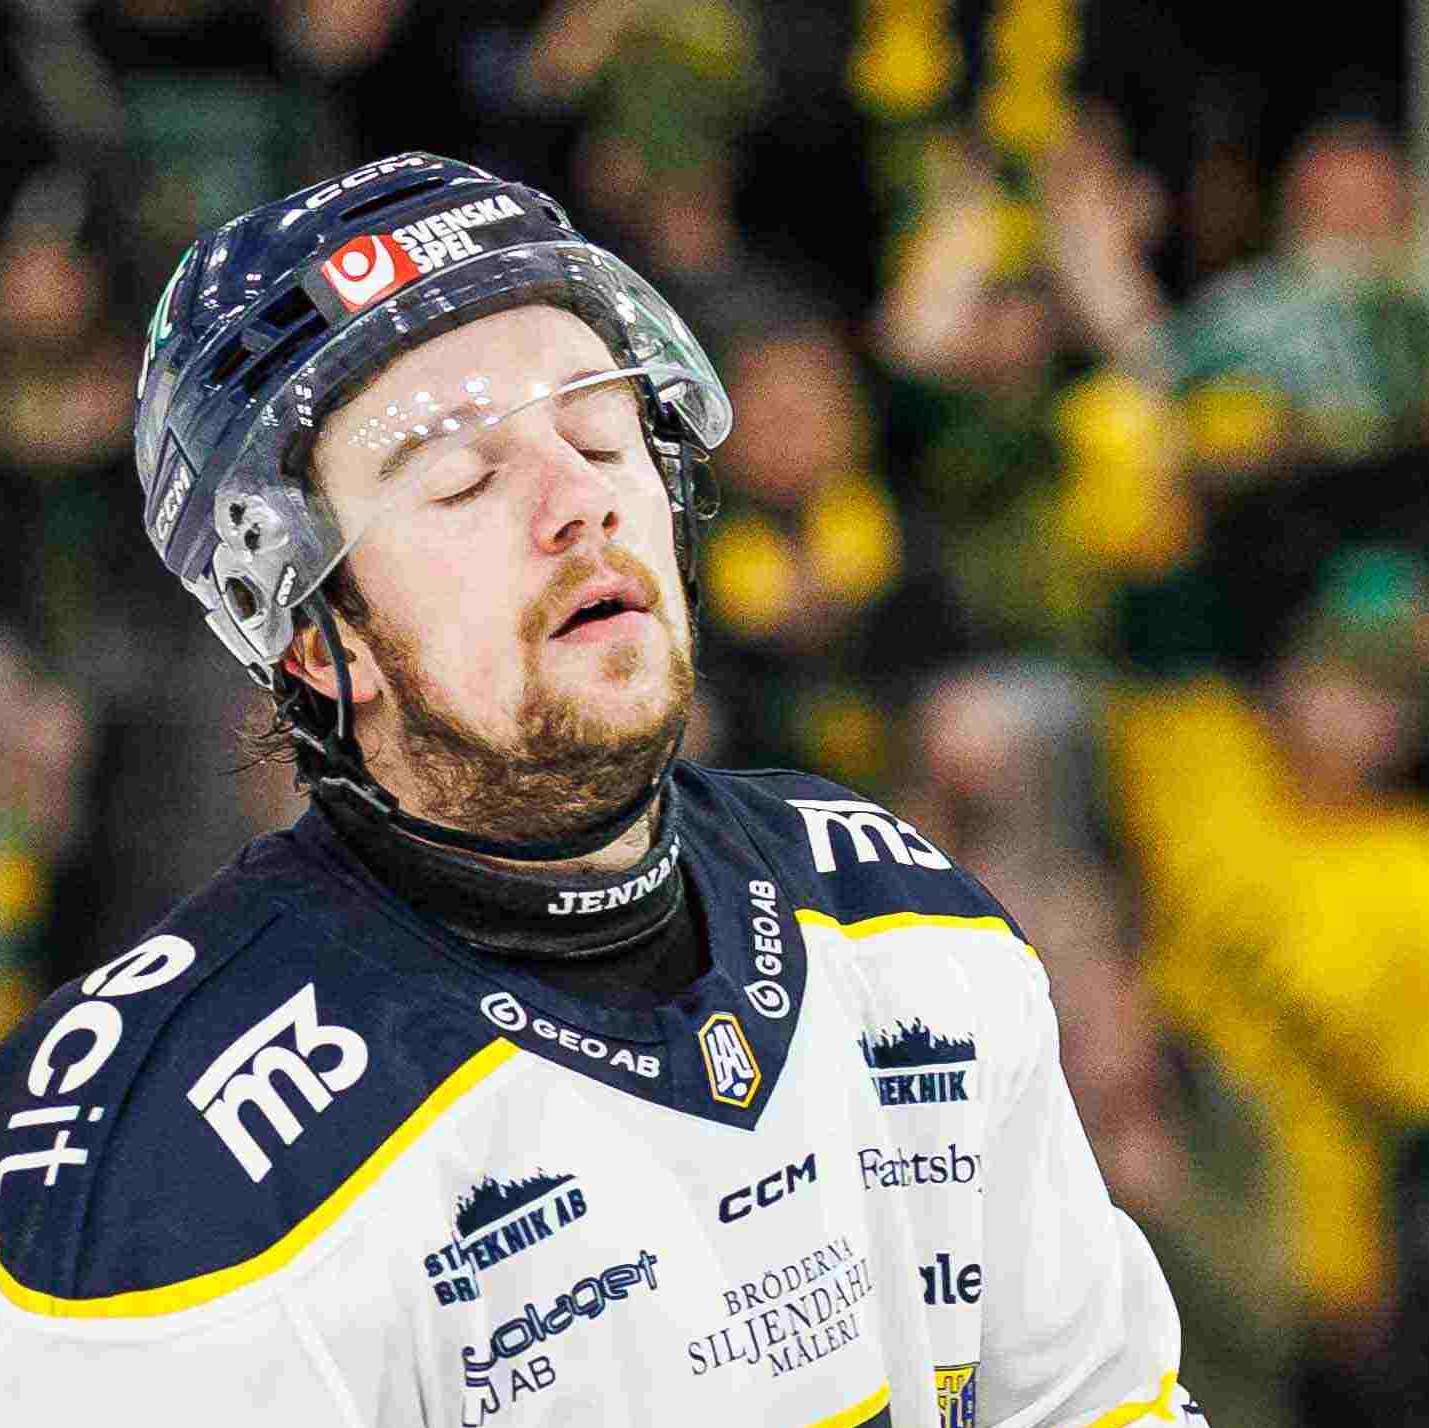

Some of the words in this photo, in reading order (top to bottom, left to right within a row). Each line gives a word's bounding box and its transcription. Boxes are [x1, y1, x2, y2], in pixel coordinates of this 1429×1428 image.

[391, 194, 526, 250] SVENSKA
[410, 230, 484, 274] SPEL
[871, 1069, 969, 1106] EKNIK
[554, 1187, 587, 1228] AB
[718, 1153, 818, 1224] CCM
[510, 1355, 558, 1402] AB
